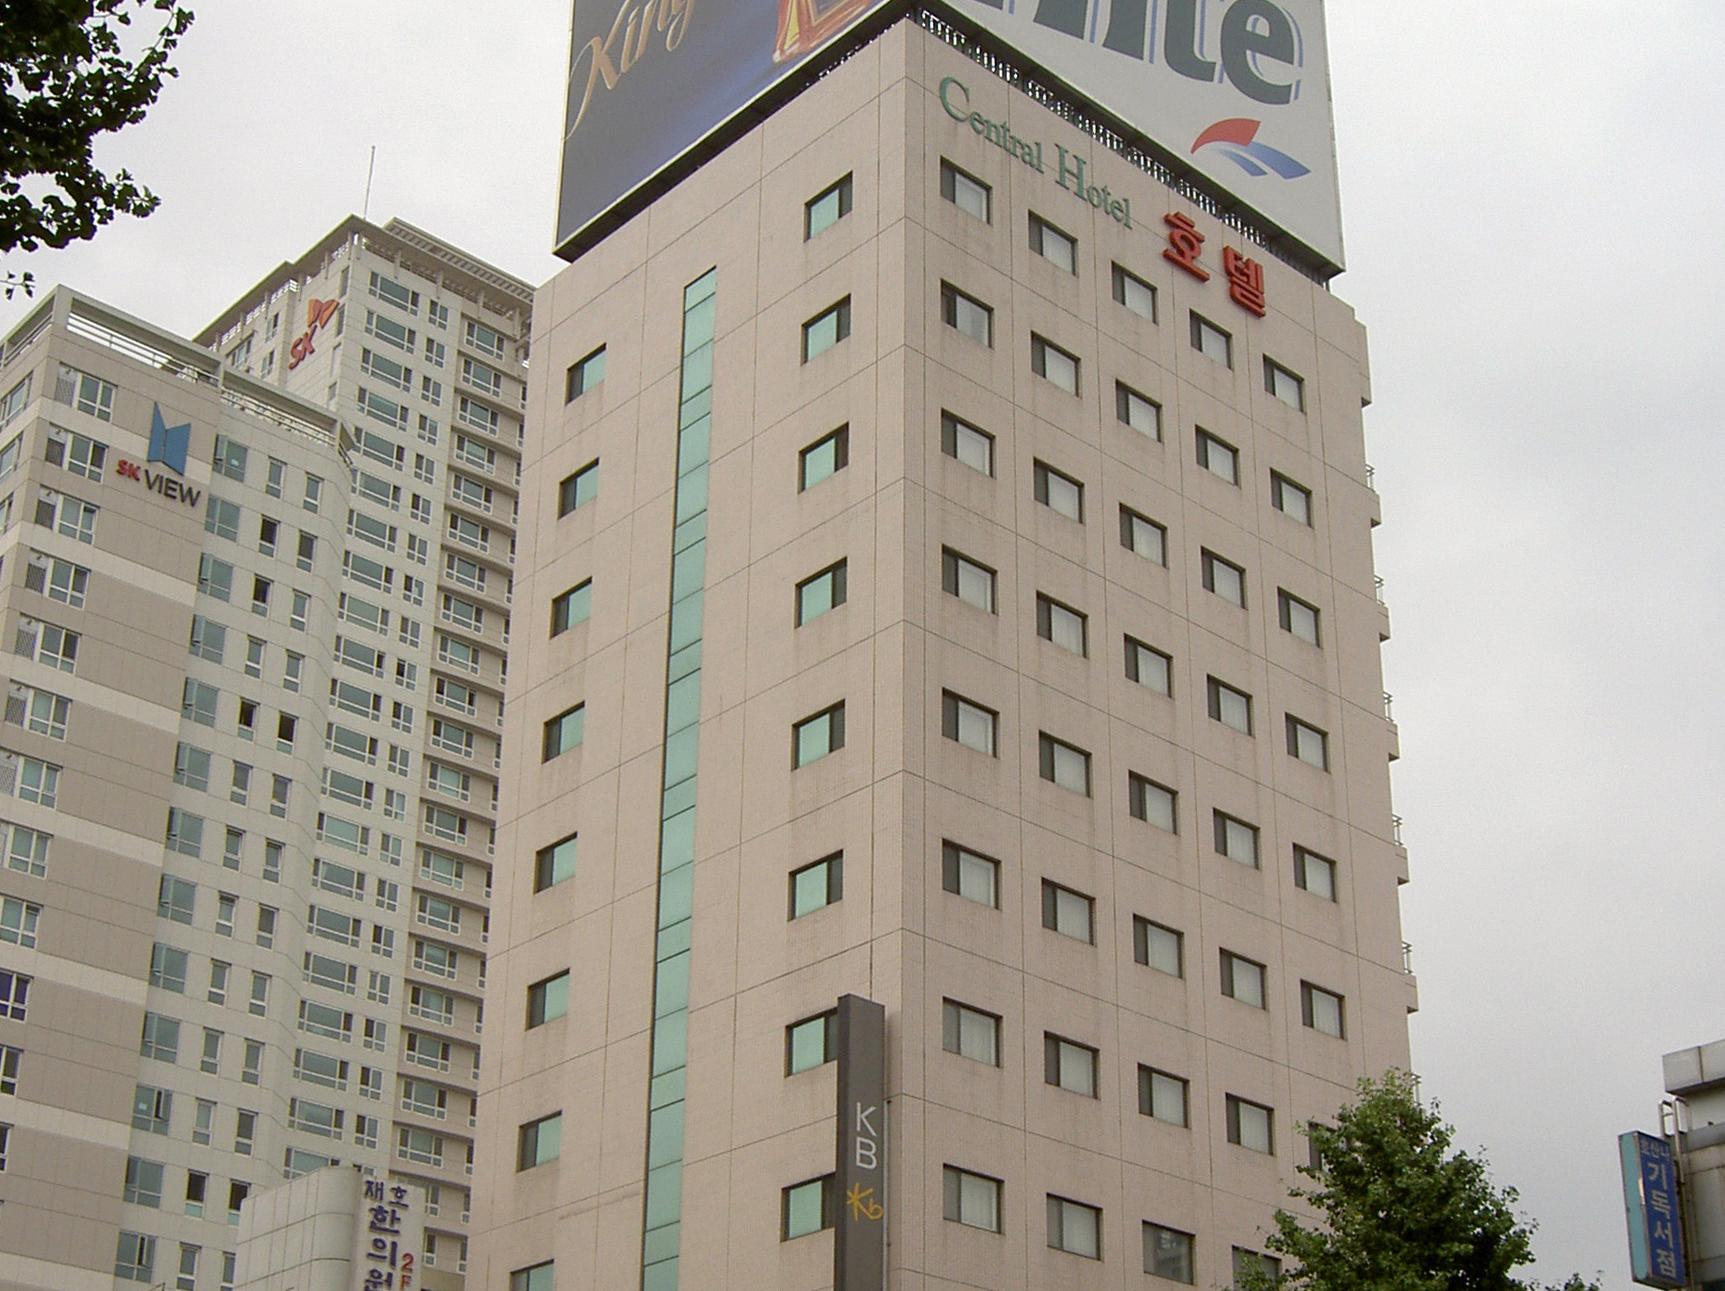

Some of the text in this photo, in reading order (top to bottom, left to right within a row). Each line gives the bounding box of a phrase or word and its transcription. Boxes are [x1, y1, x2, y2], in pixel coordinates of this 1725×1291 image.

[939, 76, 1133, 230] Central Hotel
[1163, 212, 1266, 318] 호텔
[116, 459, 201, 508] SK VIEW
[364, 1179, 409, 1208] 재호
[1647, 1162, 1677, 1279] 기독서점
